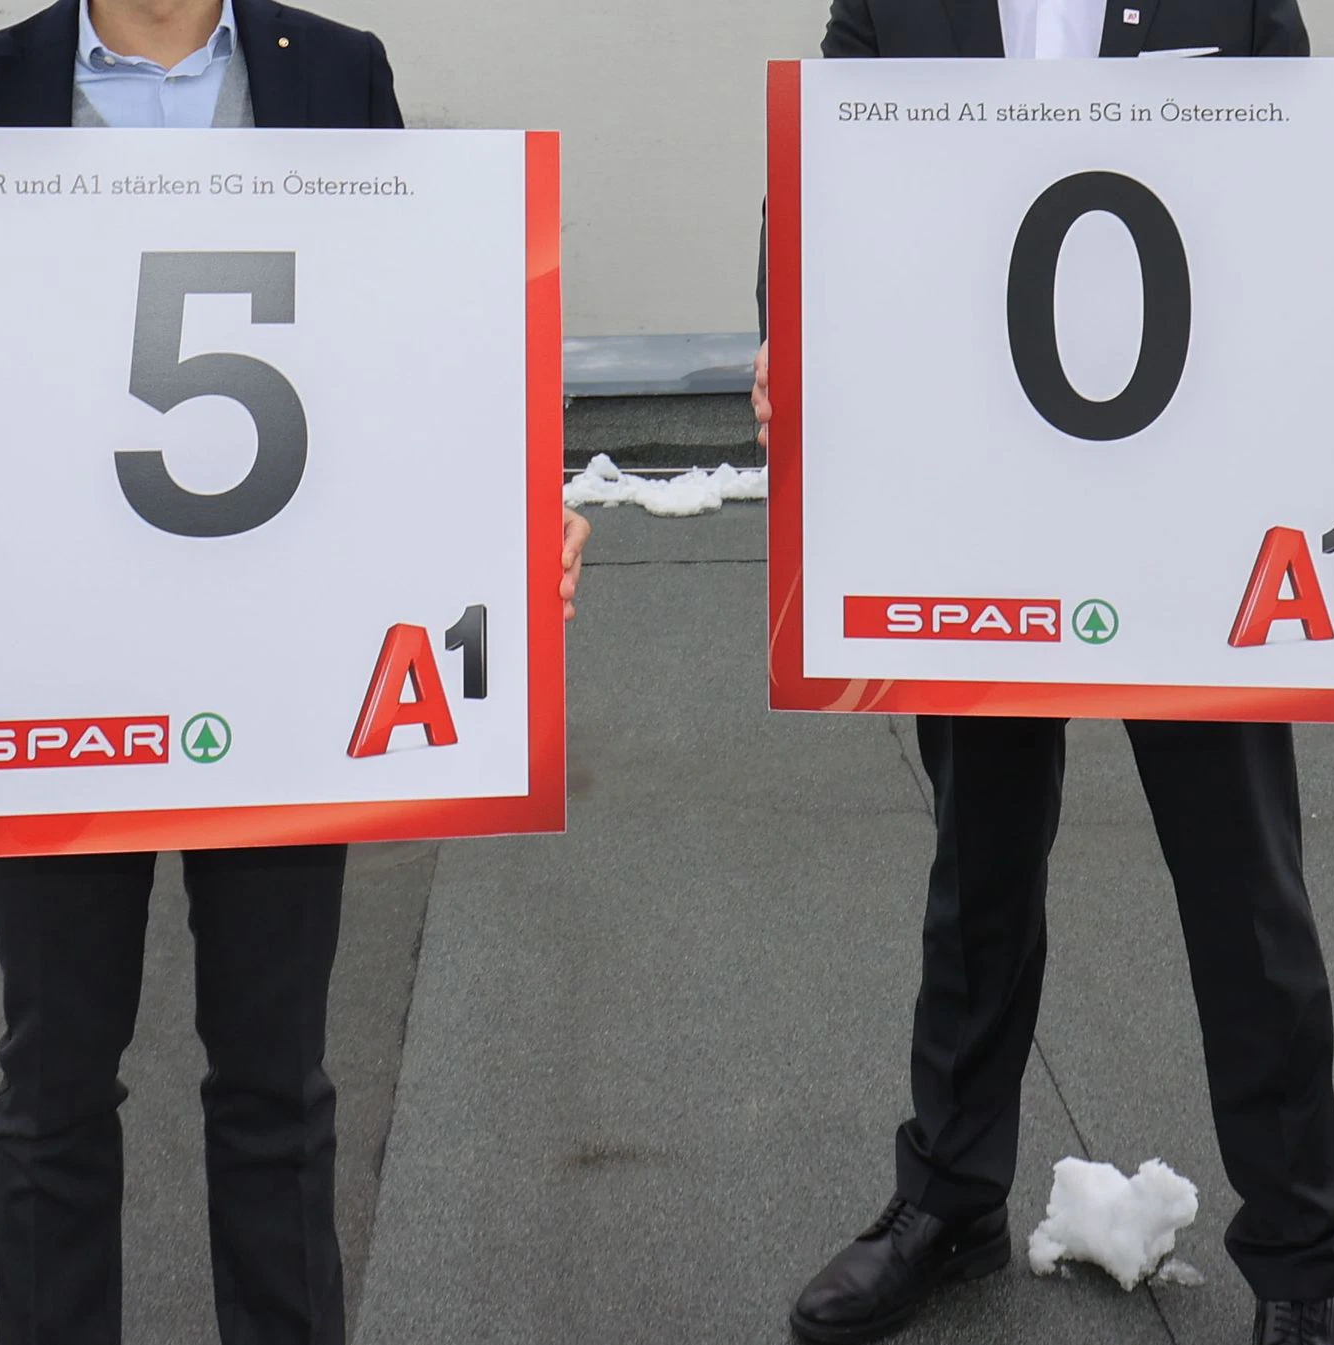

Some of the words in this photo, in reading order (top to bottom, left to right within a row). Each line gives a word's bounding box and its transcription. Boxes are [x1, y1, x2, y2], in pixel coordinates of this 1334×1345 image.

[838, 101, 900, 122] SPAR
[906, 102, 951, 122] und
[957, 102, 988, 122] A1
[996, 102, 1082, 122] stärken
[1089, 102, 1122, 122] 5G
[1130, 103, 1153, 122] in
[1160, 98, 1290, 122] Österreich.
[14, 174, 62, 195] und
[70, 174, 102, 195] A1
[111, 174, 201, 195] stärken
[209, 174, 243, 195] 5G
[252, 175, 275, 195] in
[283, 170, 415, 196] Österreich.
[1006, 170, 1192, 442] 0
[113, 251, 308, 538] 5
[886, 603, 1057, 636] SPAR
[347, 604, 488, 759] A1
